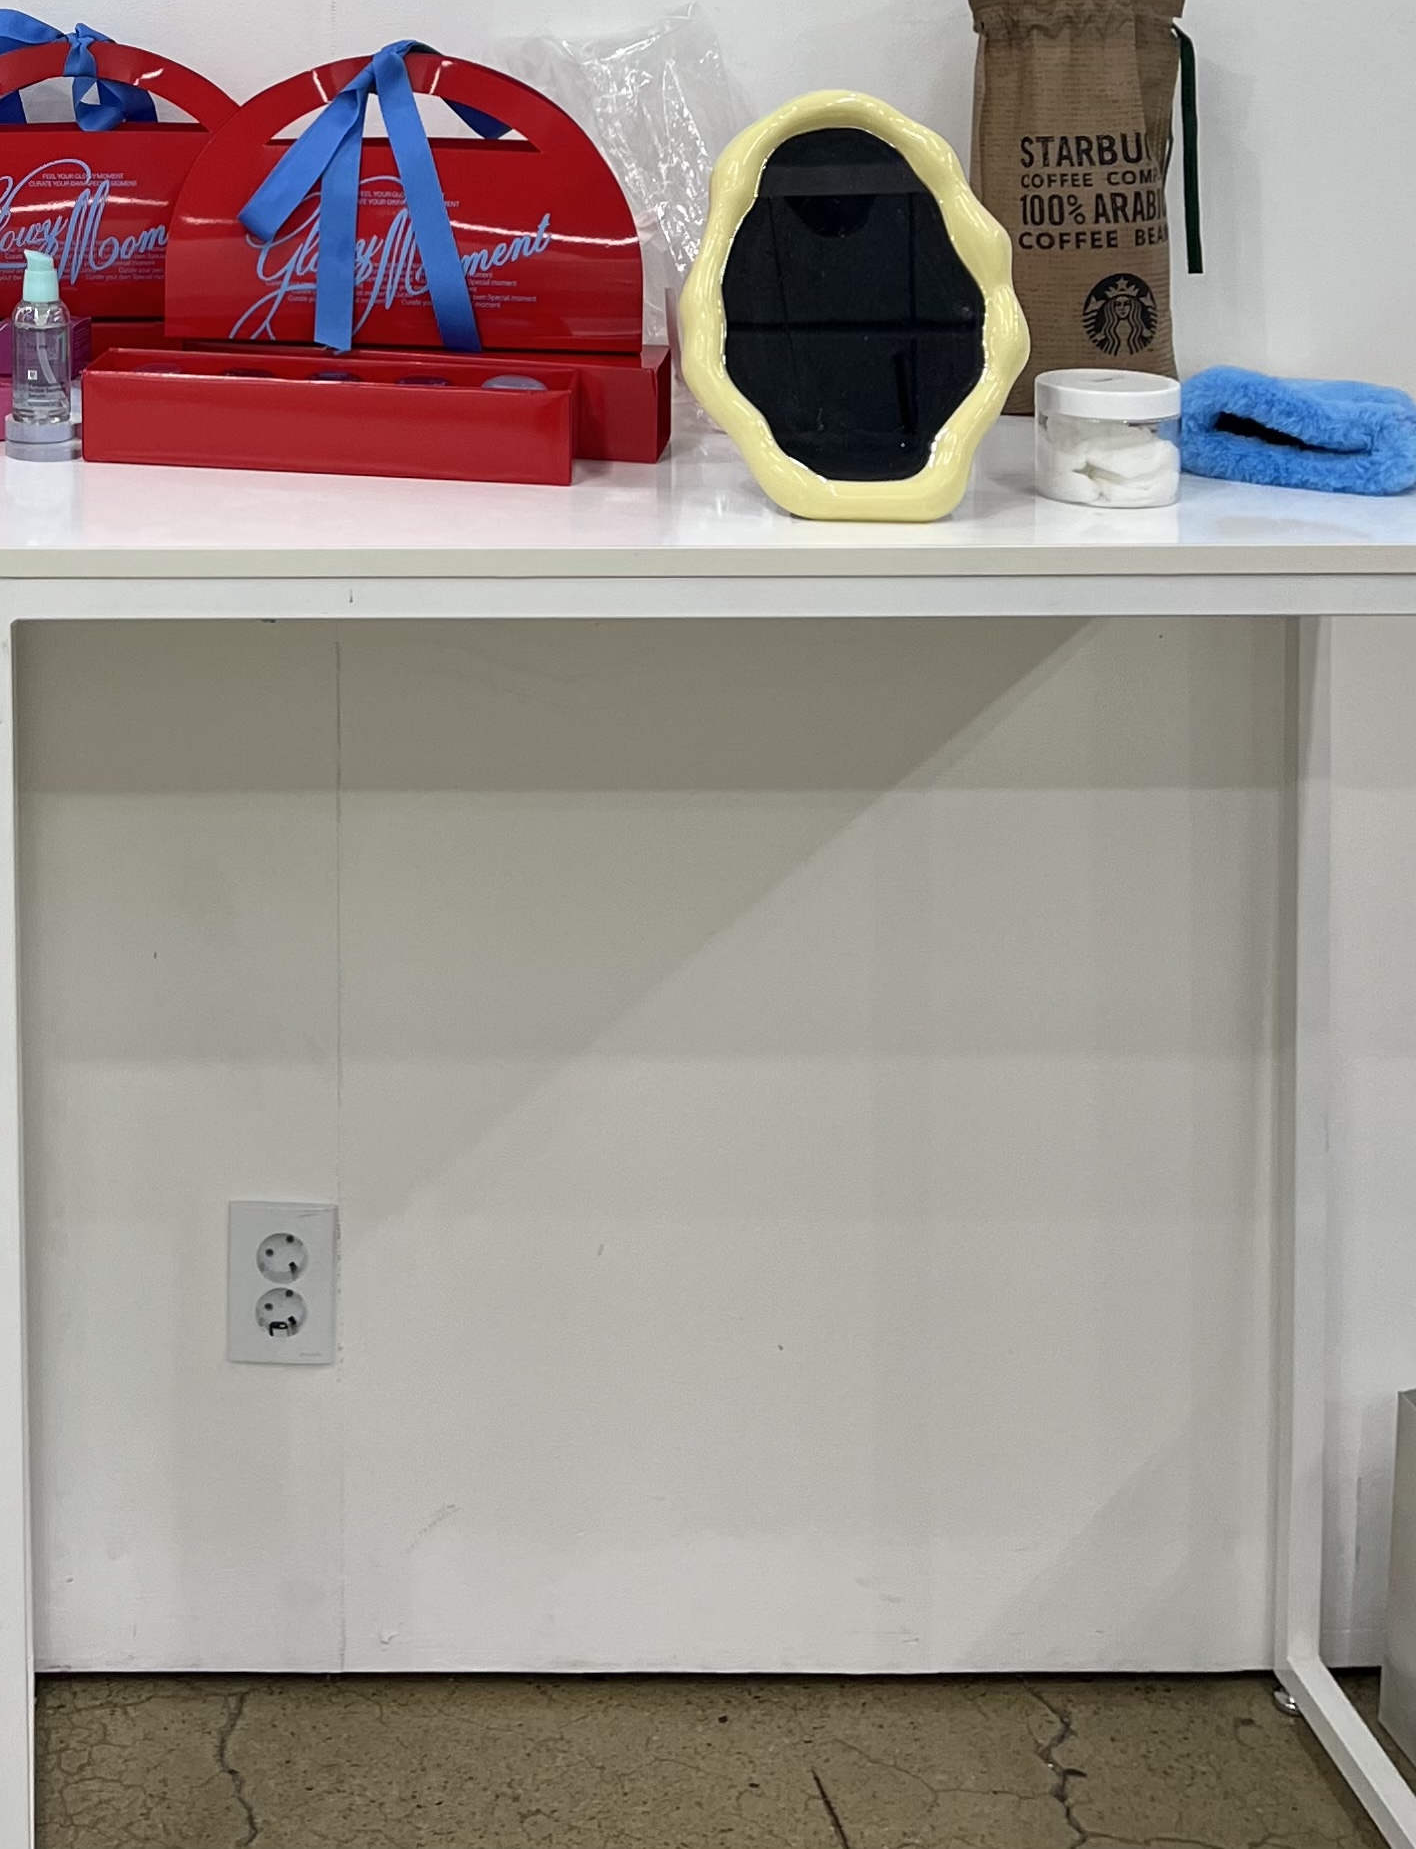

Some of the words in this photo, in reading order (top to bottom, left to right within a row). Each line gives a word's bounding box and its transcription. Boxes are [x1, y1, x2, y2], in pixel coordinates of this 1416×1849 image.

[1020, 172, 1094, 189] COFFEE
[1020, 193, 1086, 227] 100%
[1018, 230, 1118, 250] COFFEE
